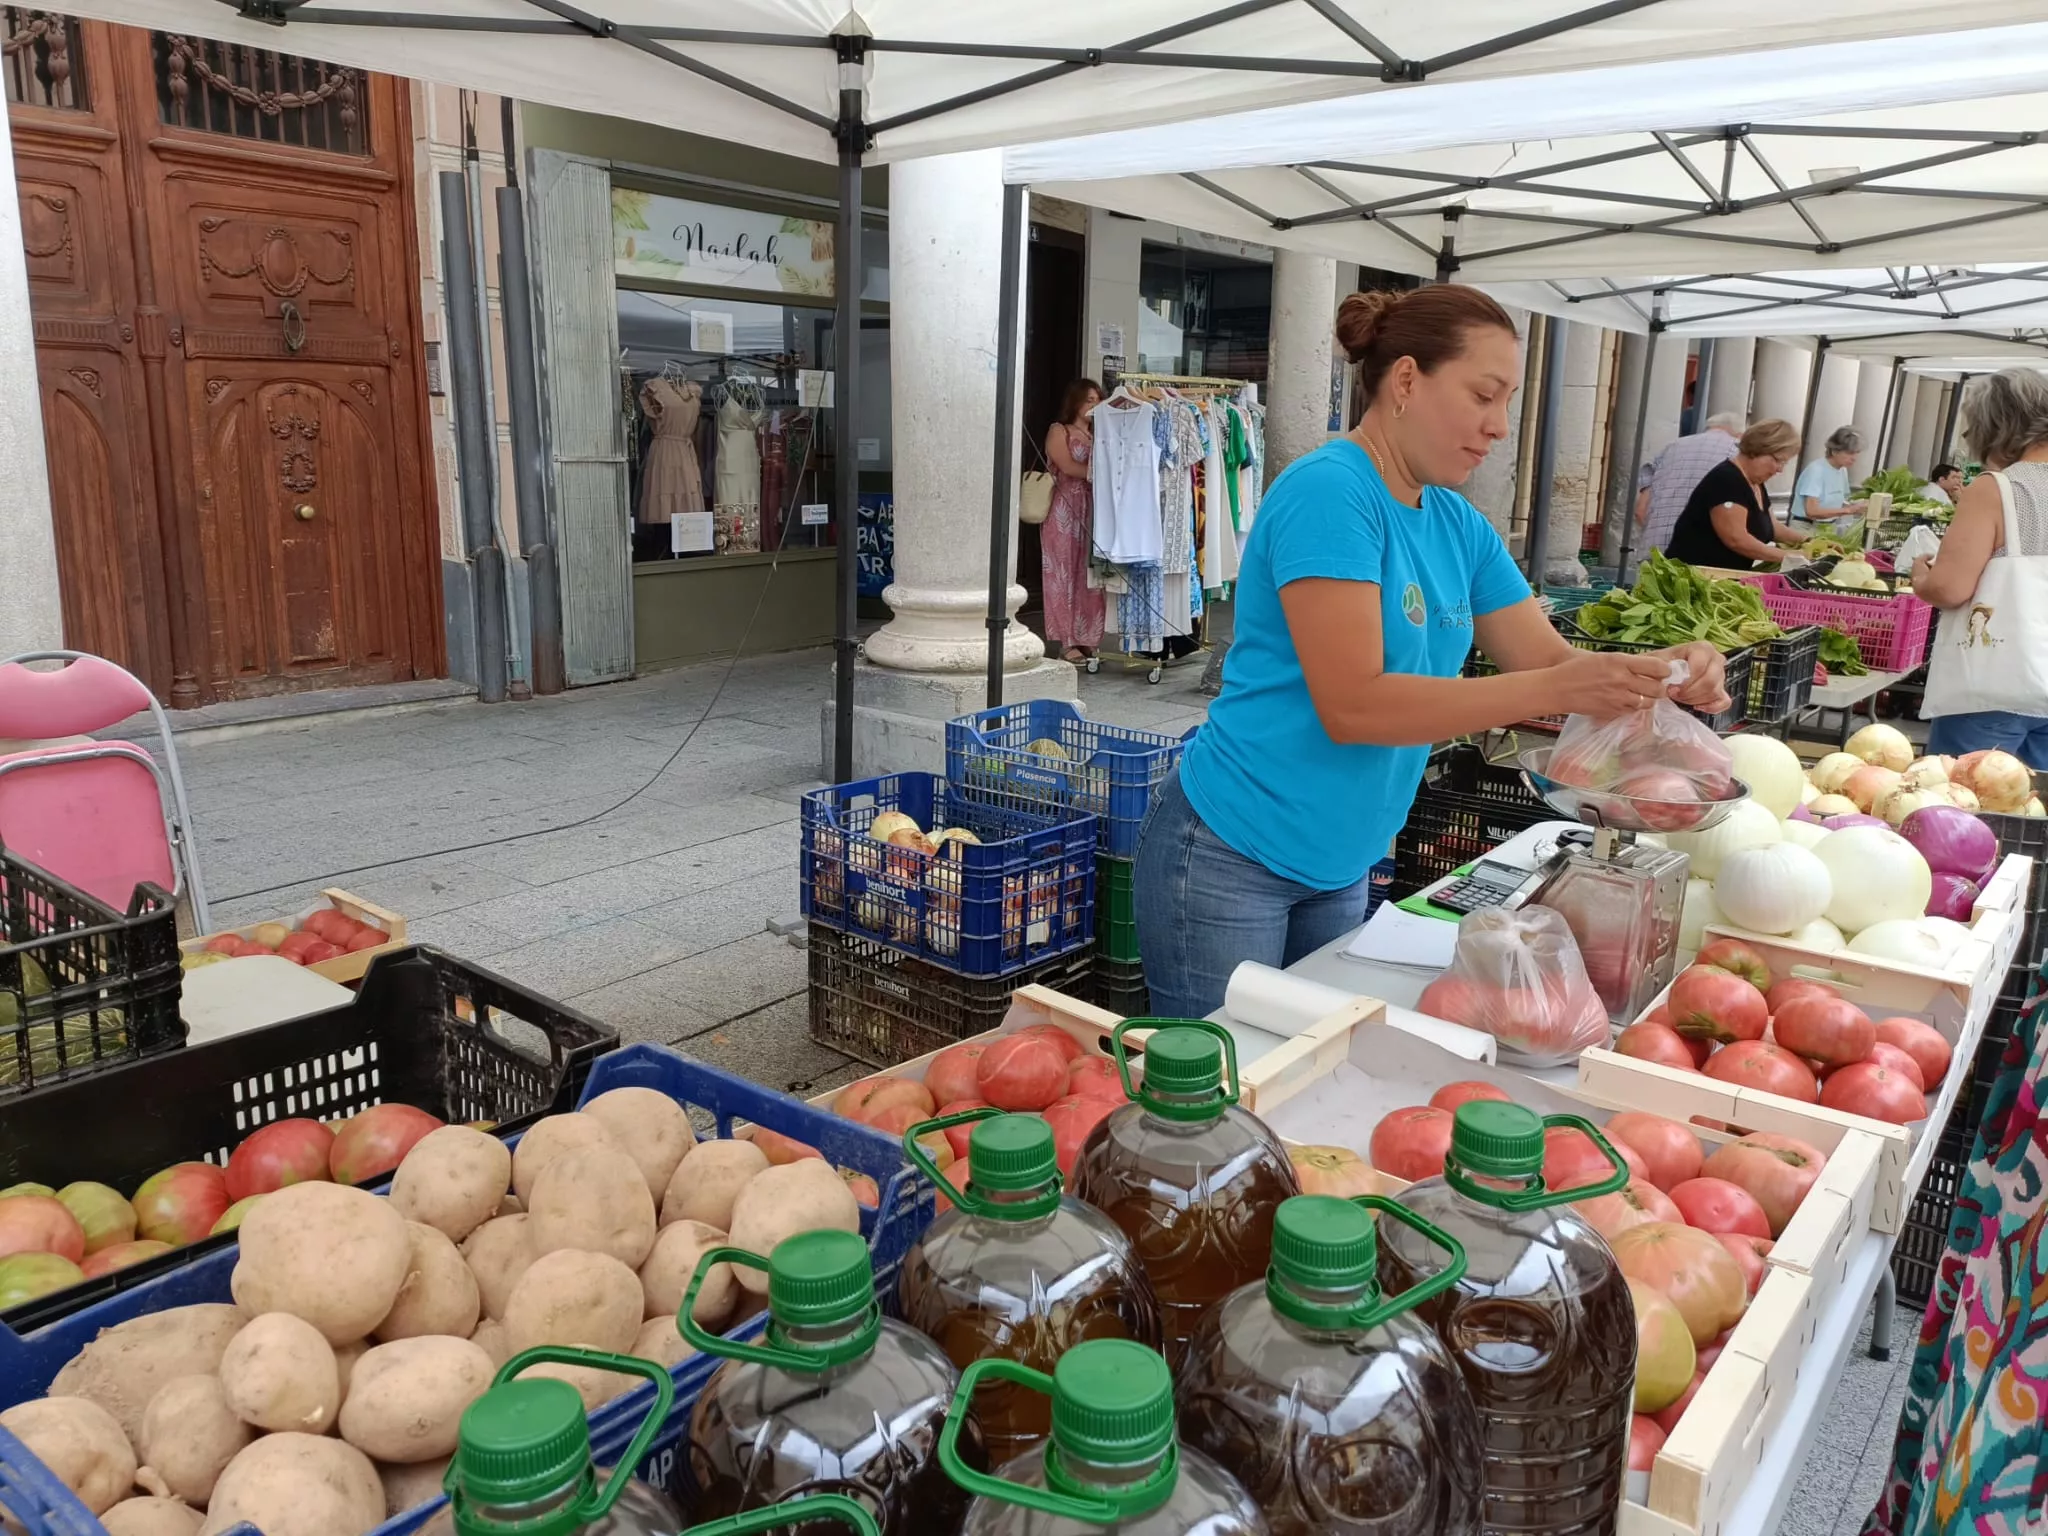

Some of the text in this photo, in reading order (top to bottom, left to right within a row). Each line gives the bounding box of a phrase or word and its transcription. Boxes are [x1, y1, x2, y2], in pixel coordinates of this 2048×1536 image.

[673, 222, 784, 268] Nailah
[1016, 768, 1057, 785] Plasencia
[865, 876, 907, 900] benihort
[648, 1443, 677, 1490] AP
